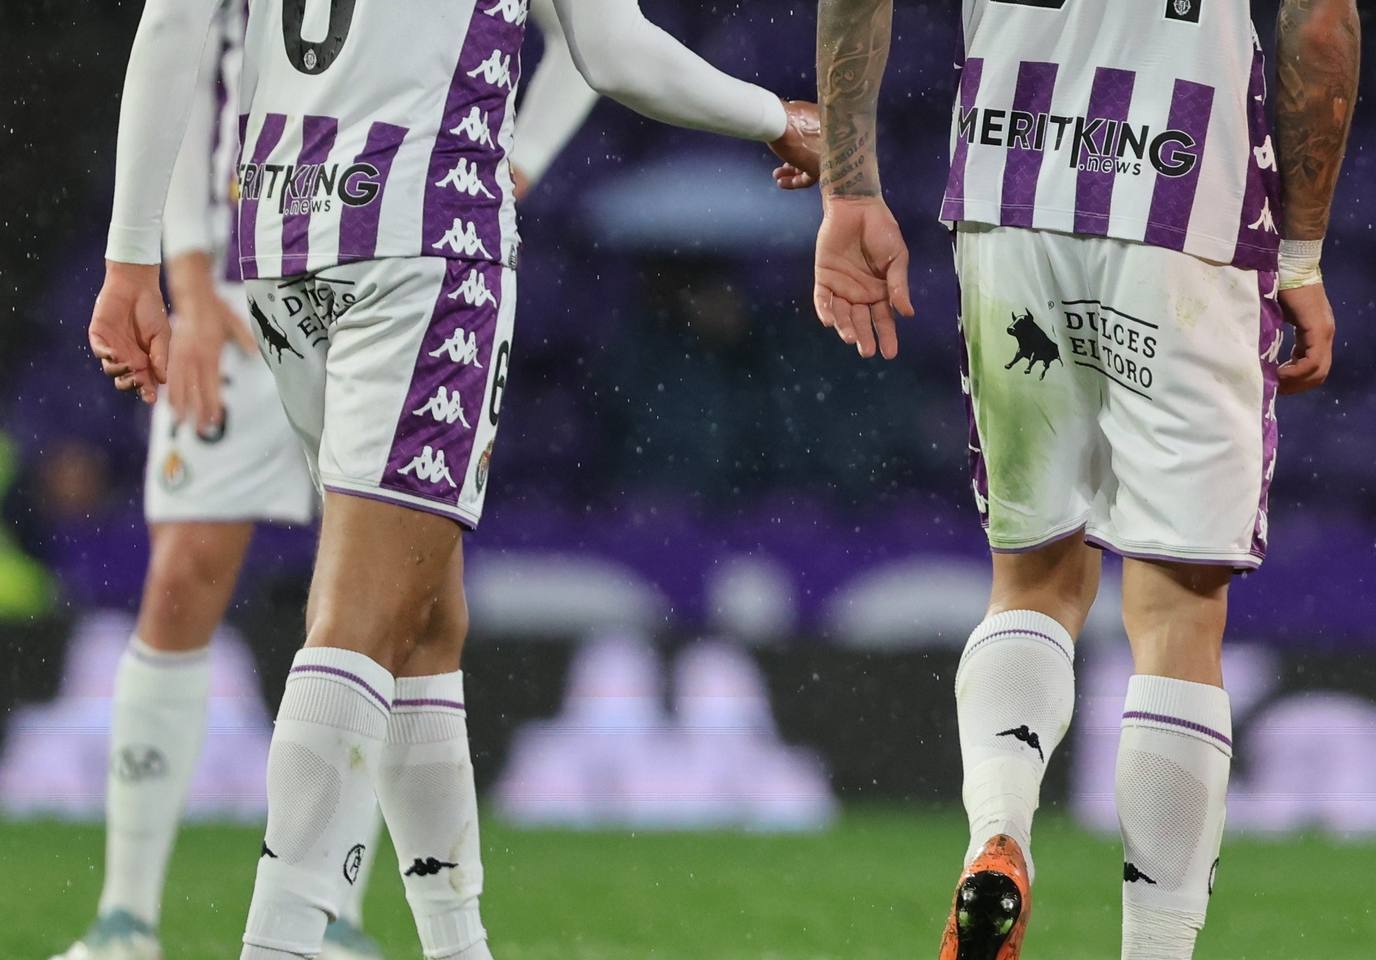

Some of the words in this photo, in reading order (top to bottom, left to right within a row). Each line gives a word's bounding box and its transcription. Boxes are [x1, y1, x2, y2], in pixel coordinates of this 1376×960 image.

[957, 106, 1197, 178] MERITKING
[1079, 155, 1142, 176] .news
[1064, 311, 1158, 358] DULCES
[1069, 337, 1101, 361] EL
[1102, 345, 1153, 389] TORO
